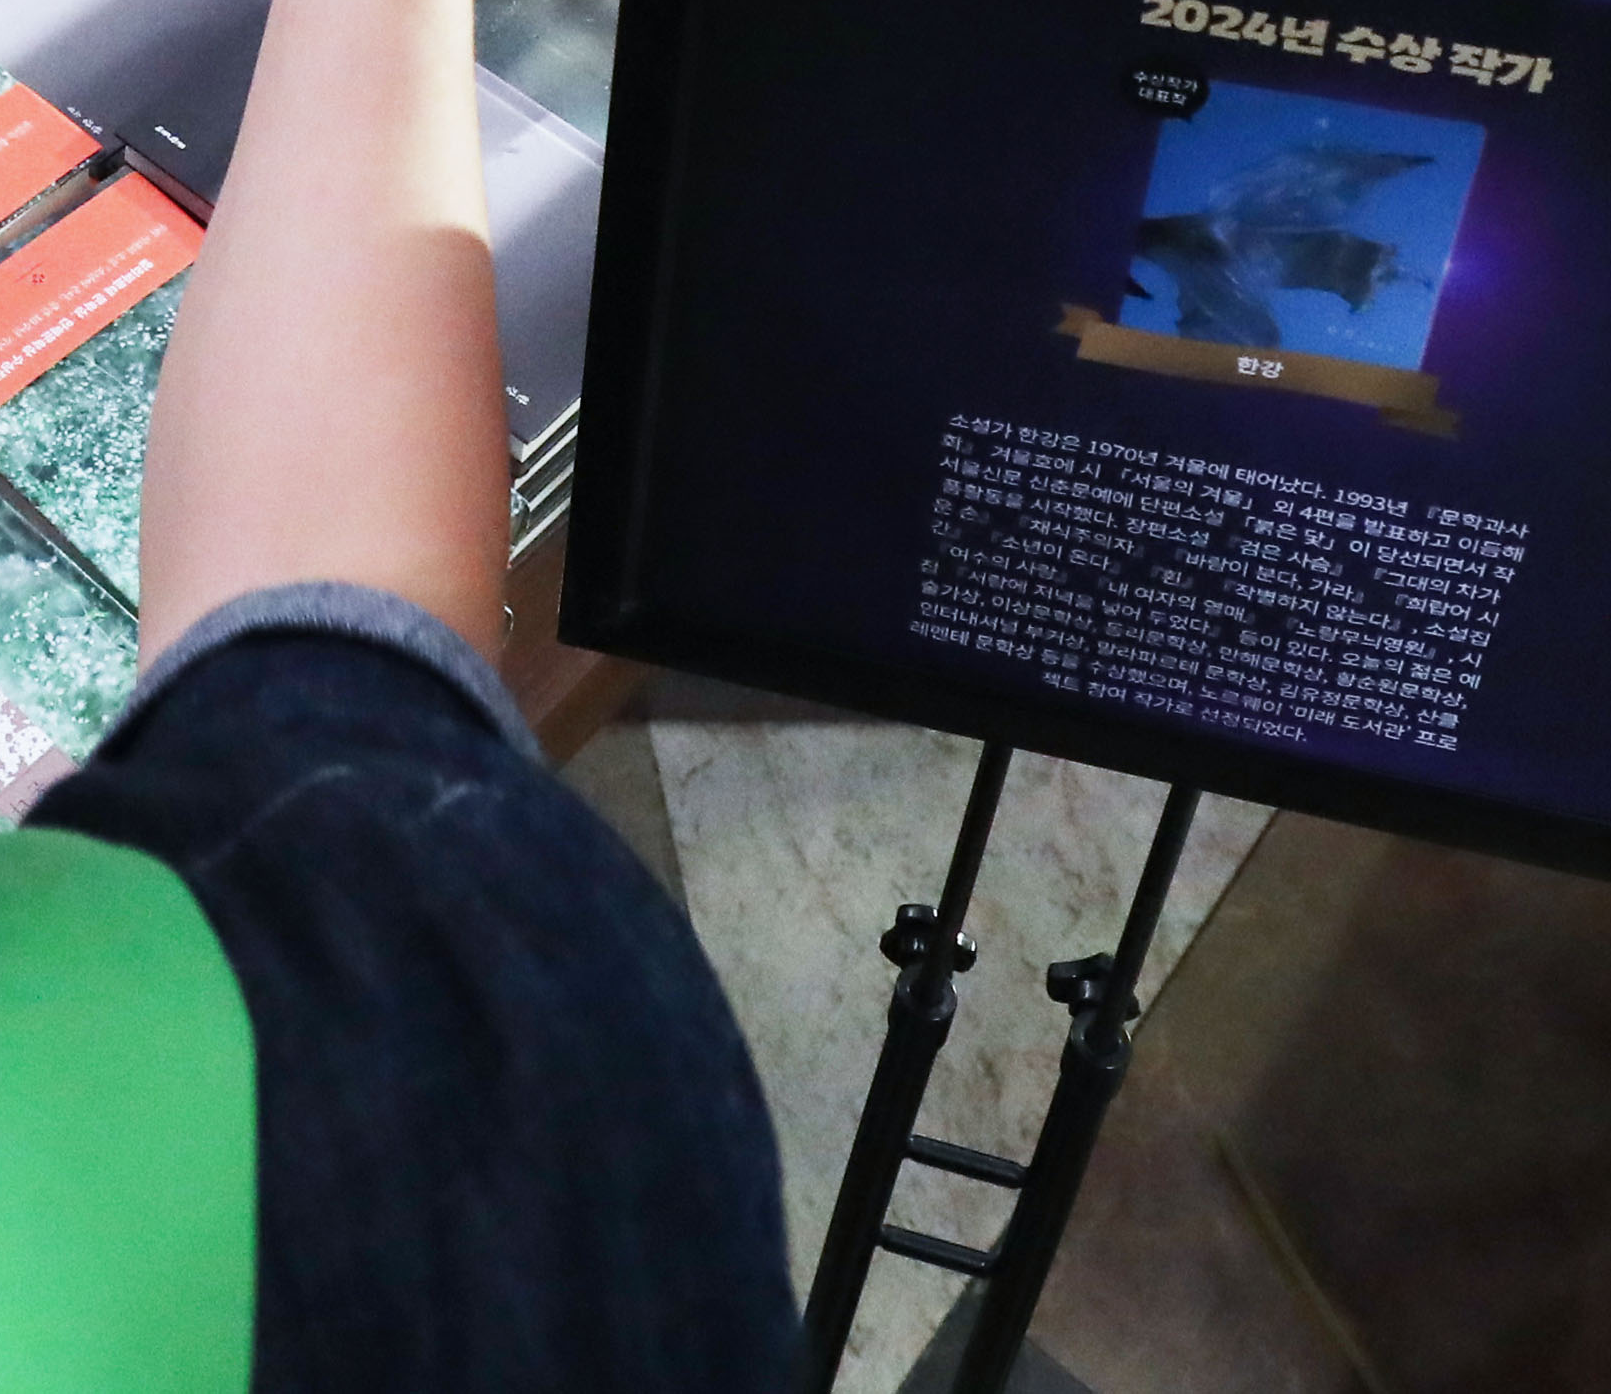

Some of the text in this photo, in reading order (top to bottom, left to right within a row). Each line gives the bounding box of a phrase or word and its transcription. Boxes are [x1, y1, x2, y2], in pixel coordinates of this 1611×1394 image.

[1334, 23, 1445, 77] 수상
[1447, 43, 1555, 97] 작가
[1236, 354, 1284, 380] 한강
[949, 413, 1012, 439] 소설가
[1018, 426, 1081, 452] 한강은
[1086, 440, 1158, 467] 1970년
[1165, 455, 1229, 481] 겨울에
[1236, 469, 1327, 501] 태어났다.
[1334, 488, 1408, 516] 1993년
[990, 445, 1074, 475] 겨울호에
[1081, 463, 1103, 481] 시
[1272, 500, 1294, 518] 외
[1299, 506, 1356, 530] 4편을
[1363, 518, 1450, 549] 발표하고
[938, 456, 1022, 487] 서울신문
[1028, 474, 1133, 509] 신춘문예에
[1139, 497, 1225, 527] 단편소설
[1377, 544, 1487, 580] 당선되면서
[1493, 567, 1516, 585] 작
[1030, 498, 1119, 530] 시작했다.
[1126, 517, 1210, 548] 장편소설
[1456, 583, 1502, 606] 차가
[1135, 584, 1197, 610] 여자의
[1461, 652, 1482, 670] 시
[1425, 621, 1492, 648] 소설집
[1477, 610, 1500, 628] 시
[1286, 636, 1334, 660] 있다.
[1338, 647, 1404, 674] 오늘의
[1458, 672, 1482, 691] 예
[1415, 727, 1459, 750] 프로
